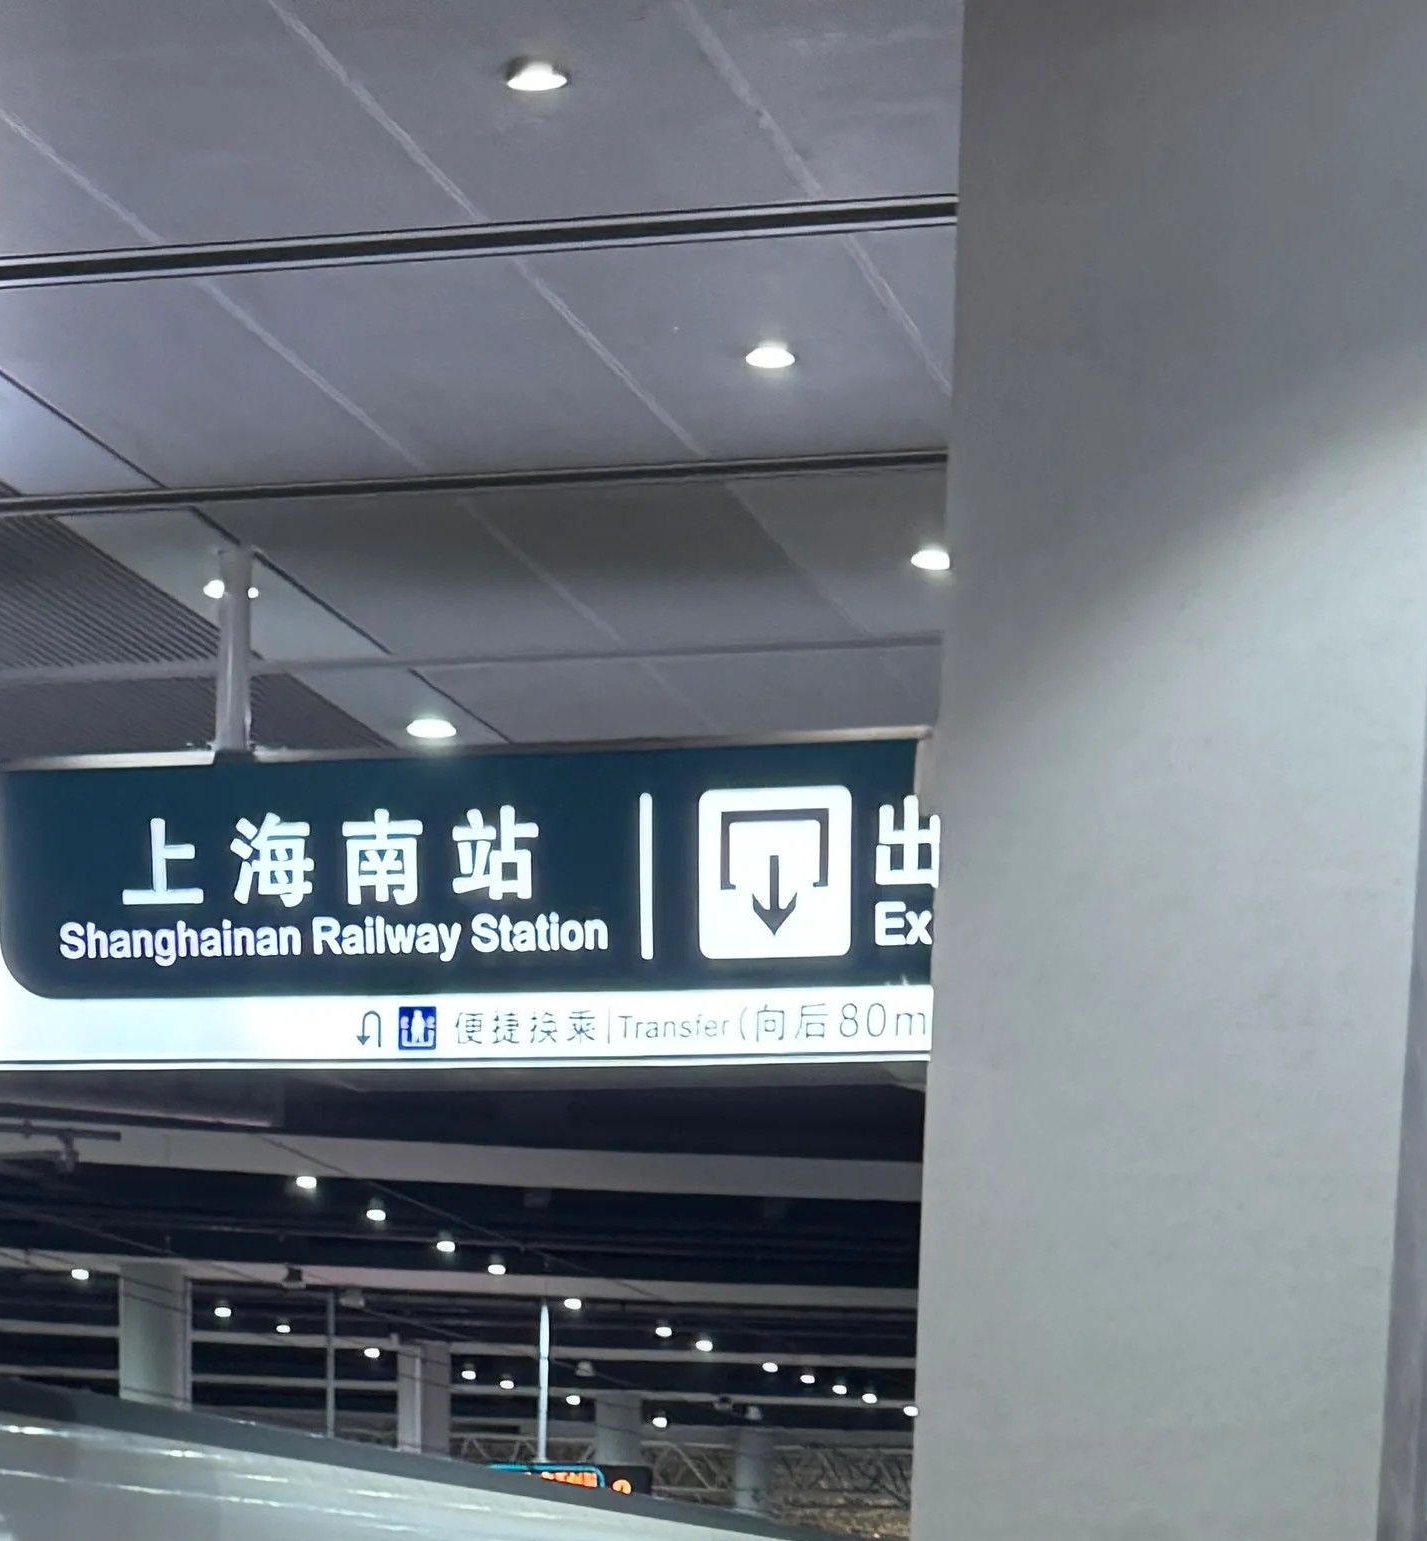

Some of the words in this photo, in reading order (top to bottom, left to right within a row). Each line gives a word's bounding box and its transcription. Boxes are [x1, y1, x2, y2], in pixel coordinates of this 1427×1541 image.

[122, 804, 539, 907] 上海南站
[59, 919, 302, 967] Shanghainan
[312, 915, 462, 962] Railway
[471, 911, 609, 953] Station
[455, 1009, 596, 1044] 便捷换乘
[617, 1013, 731, 1039] Transfer
